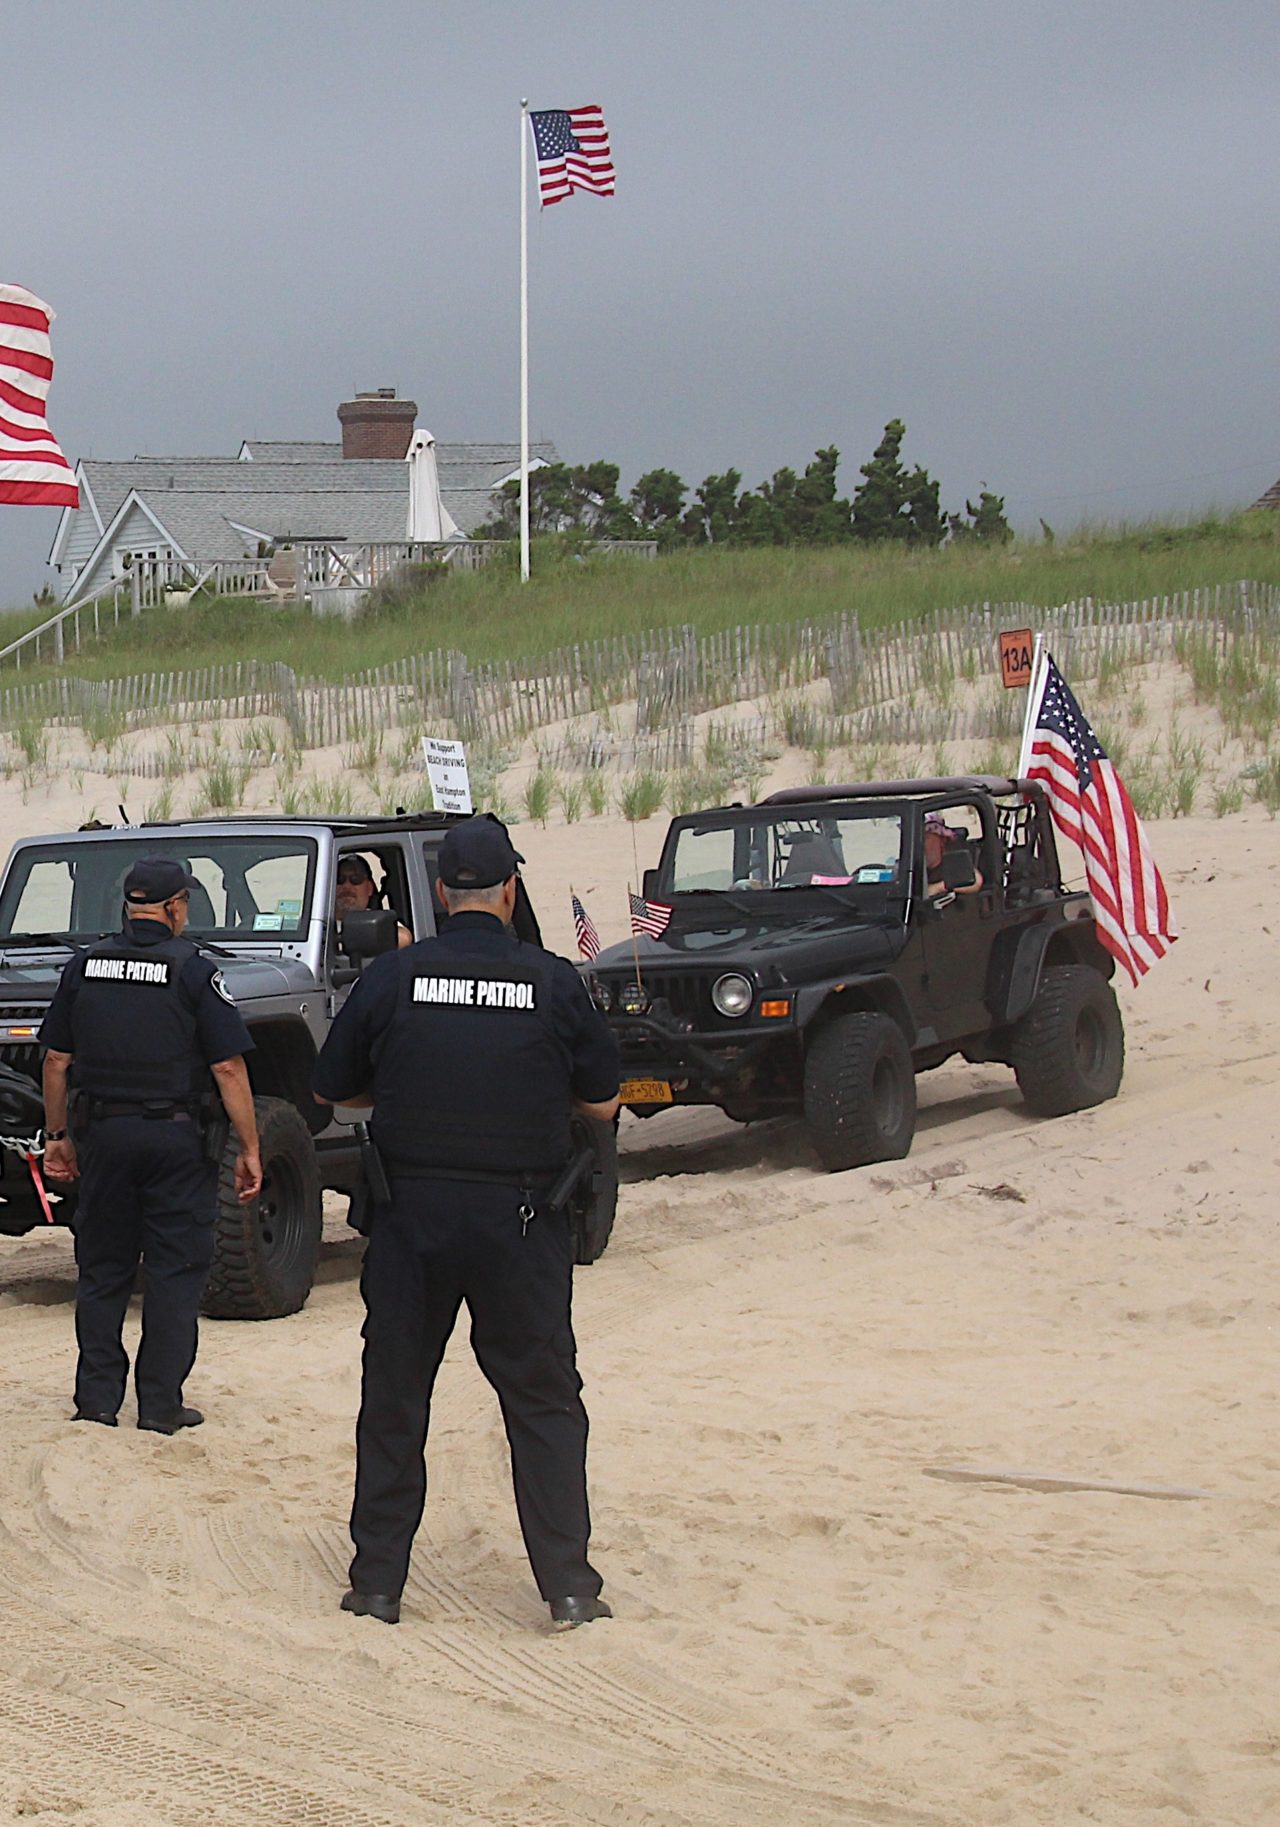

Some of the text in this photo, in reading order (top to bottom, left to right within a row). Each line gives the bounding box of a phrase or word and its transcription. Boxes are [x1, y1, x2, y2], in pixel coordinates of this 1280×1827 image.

[1003, 646, 1032, 673] 13A
[85, 958, 168, 983] MARINE PATROL
[413, 977, 535, 1009] MARINE PATROL
